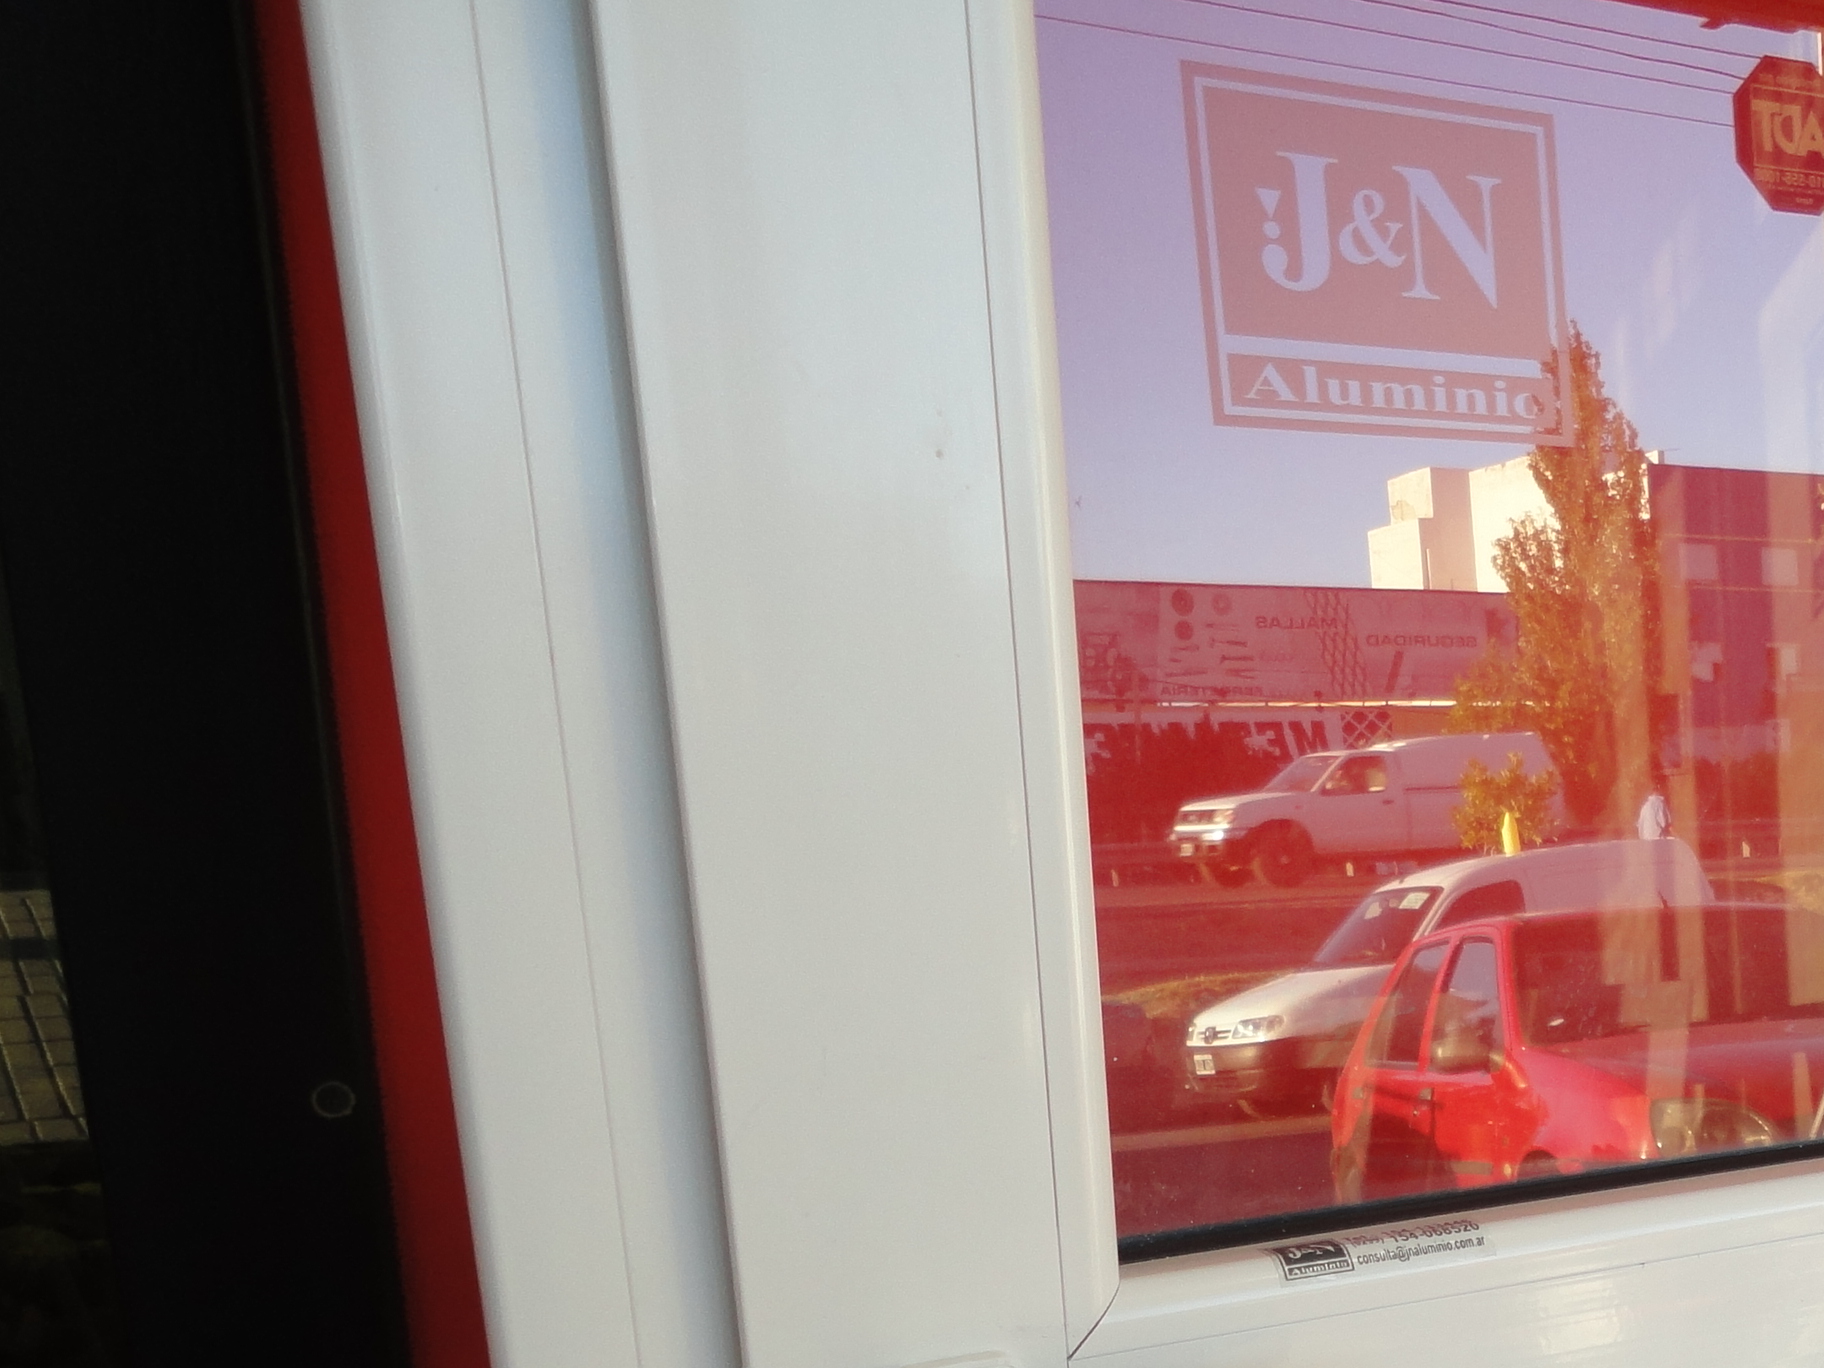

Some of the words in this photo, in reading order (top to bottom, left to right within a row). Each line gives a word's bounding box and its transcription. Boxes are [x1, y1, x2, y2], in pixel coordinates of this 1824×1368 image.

[1257, 150, 1502, 310] J&N
[1243, 361, 1545, 420] Aluminio
[1356, 1236, 1485, 1266] consulta@jnaluminio.com.ar
